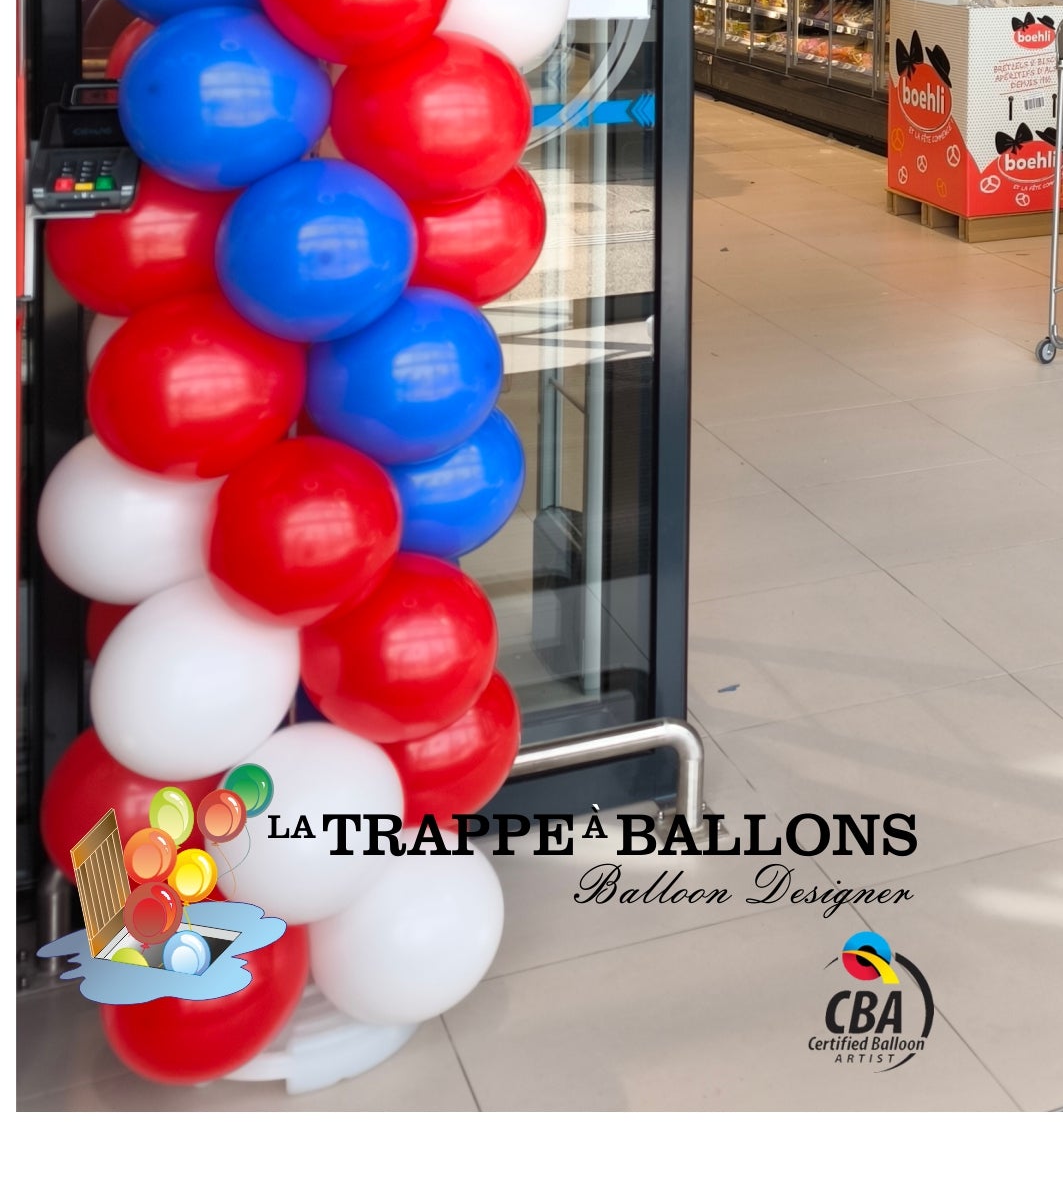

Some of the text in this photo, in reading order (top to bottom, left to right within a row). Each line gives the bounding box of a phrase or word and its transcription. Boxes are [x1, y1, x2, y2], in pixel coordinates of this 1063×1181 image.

[1017, 30, 1051, 43] boehli
[902, 76, 945, 115] boehli
[1004, 150, 1056, 172] boehli
